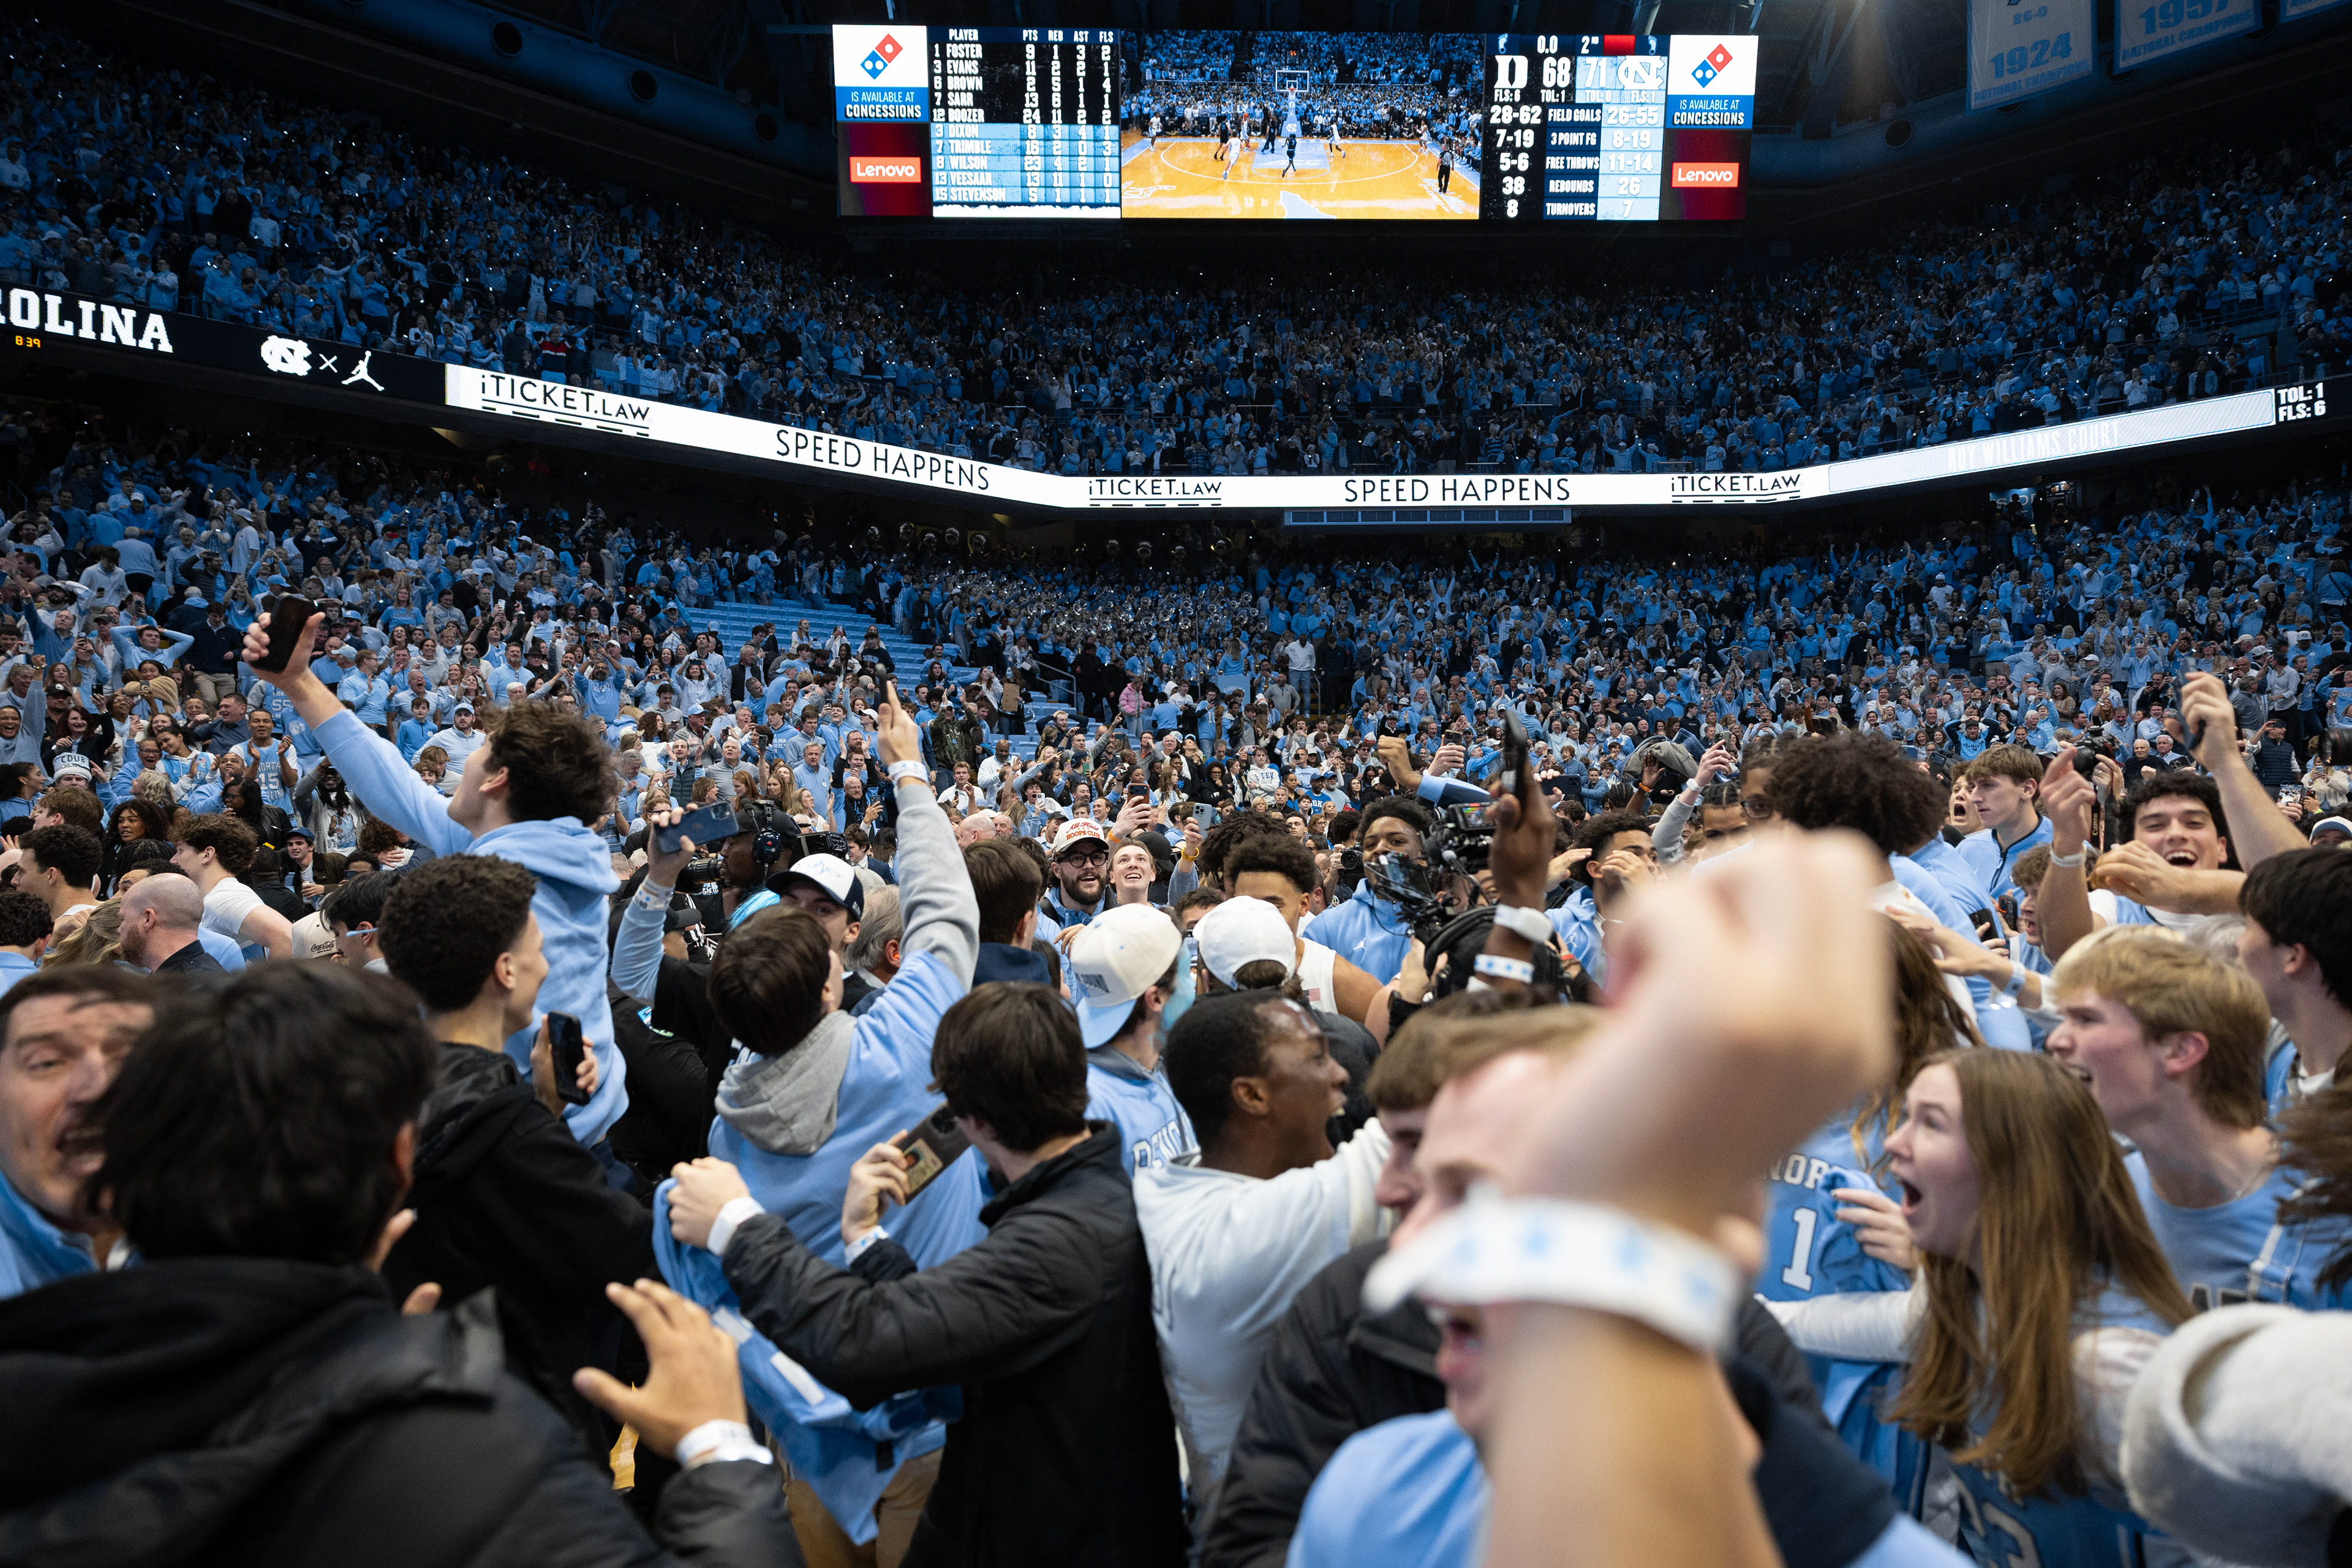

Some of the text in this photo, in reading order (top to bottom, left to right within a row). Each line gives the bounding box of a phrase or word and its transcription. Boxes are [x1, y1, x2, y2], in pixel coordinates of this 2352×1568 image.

[949, 29, 1114, 42] PLAYER PTS REB AST FLS
[2123, 9, 2253, 61] NATIONAL CHAMPIONS
[935, 45, 1110, 60] 1 FOSTER 9 1 3 2
[1537, 36, 1599, 54] 0.0 2ND
[1991, 32, 2072, 79] 1924
[933, 61, 1109, 76] 3 EVANS 11 2 2 1
[1495, 55, 1528, 88] D
[1543, 57, 1570, 88] 68
[1585, 58, 1607, 88] 71
[934, 77, 1111, 92] 6 BROWN 2 5 1 4
[1974, 59, 2090, 102] NATIONAL CHAMPIONS
[851, 92, 914, 102] IS AVAILABLE AT
[935, 92, 1109, 108] 7 SARR 13 6 1 1
[1494, 91, 1520, 102] FLS: 6
[1541, 91, 1565, 102] TOL: 1
[1586, 91, 1611, 102] TOL: 0
[1631, 91, 1656, 102] FLS: 1
[846, 105, 921, 118] CONCESSIONS
[1680, 100, 1740, 110] IS AVAILABLE AT
[933, 109, 1111, 124] 12 BOOZER 24 11 2 2
[1490, 105, 1658, 125] 28-62 FIELD GOALS 26-55
[1673, 112, 1744, 126] CONCESSIONS
[936, 124, 1110, 140] 3 DIXON 8 3 4 1
[1496, 129, 1651, 148] 7-19 3 POINT FG 8-19
[937, 140, 1112, 156] 7 TRIMBLE 16 2 0 3
[857, 162, 915, 176] Lenovo
[937, 156, 1110, 171] 8 WILSON 23 4 2 1
[1499, 153, 1653, 172] 5-6 FREE THROWS 11-14
[935, 172, 1112, 187] 13 VEESAAR 13 11 1 0
[1678, 168, 1733, 182] Lenovo
[1502, 176, 1640, 195] 38 REBOUNDS 26
[935, 187, 948, 200] 15
[951, 187, 1006, 202] STEVENSON
[1028, 188, 1038, 202] 5
[1055, 188, 1060, 202] 1
[1080, 189, 1085, 203] 1
[1105, 189, 1110, 203] 1
[1507, 199, 1634, 217] 8 TURNOVERS 7
[0, 288, 173, 353] OLINA
[15, 335, 41, 349] 8:39
[481, 374, 650, 423] iTICKET.LAW
[2277, 382, 2323, 405] TOL: 1
[2278, 400, 2326, 422] FLS: 6
[1948, 420, 2120, 471] ROY WILLIAMS COURT
[776, 429, 989, 491] SPEED HAPPENS
[1089, 479, 1222, 496] iTICKET.LAW
[1345, 478, 1570, 502] SPEED HAPPENS
[1671, 473, 1800, 492] iTICKET.LAW
[61, 754, 86, 764] CDUB
[258, 773, 280, 790] 15
[2091, 816, 2100, 837] Canon
[1066, 830, 1087, 841] HOOPS
[1782, 1207, 1818, 1292] 1
